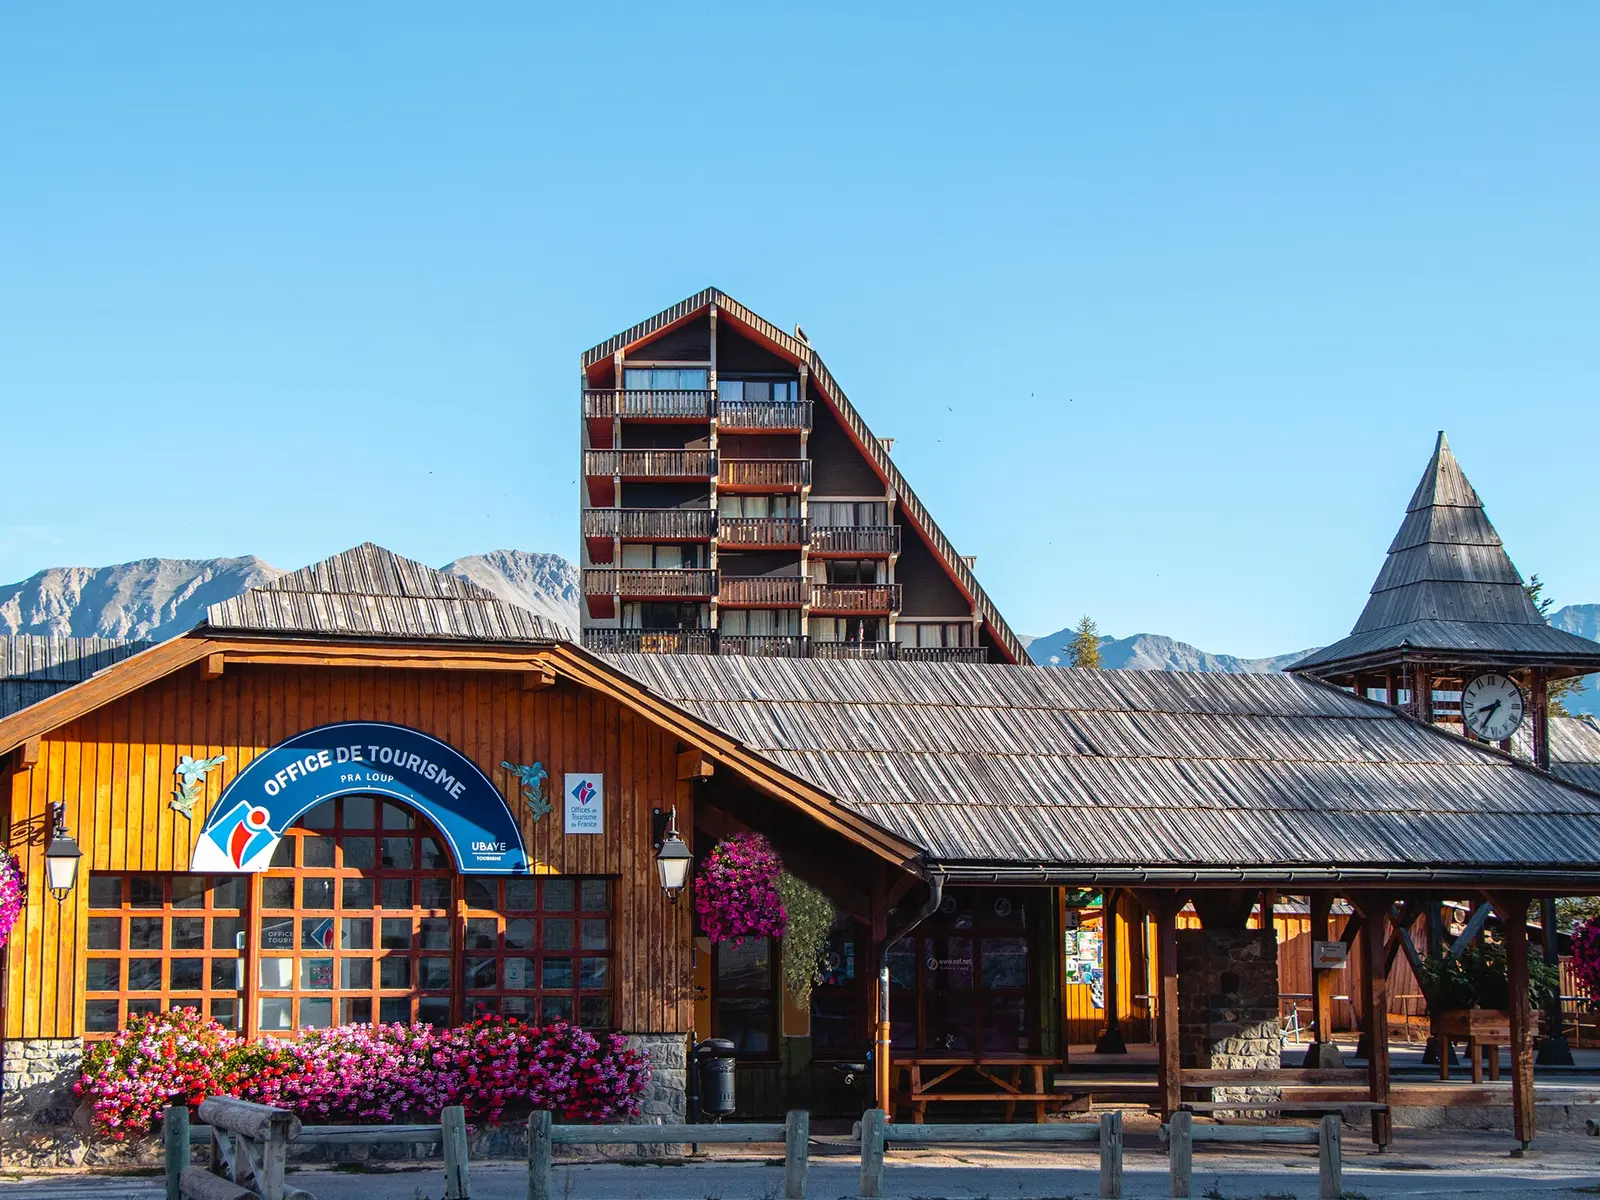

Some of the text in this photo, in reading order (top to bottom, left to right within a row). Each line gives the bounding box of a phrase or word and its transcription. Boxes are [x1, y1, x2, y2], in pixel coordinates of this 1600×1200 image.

[264, 745, 466, 799] OFFICE DE TOURISME
[340, 773, 394, 783] PRA LOUP
[571, 806, 591, 814] Offices
[577, 820, 598, 828] France
[471, 841, 506, 851] UBAYE
